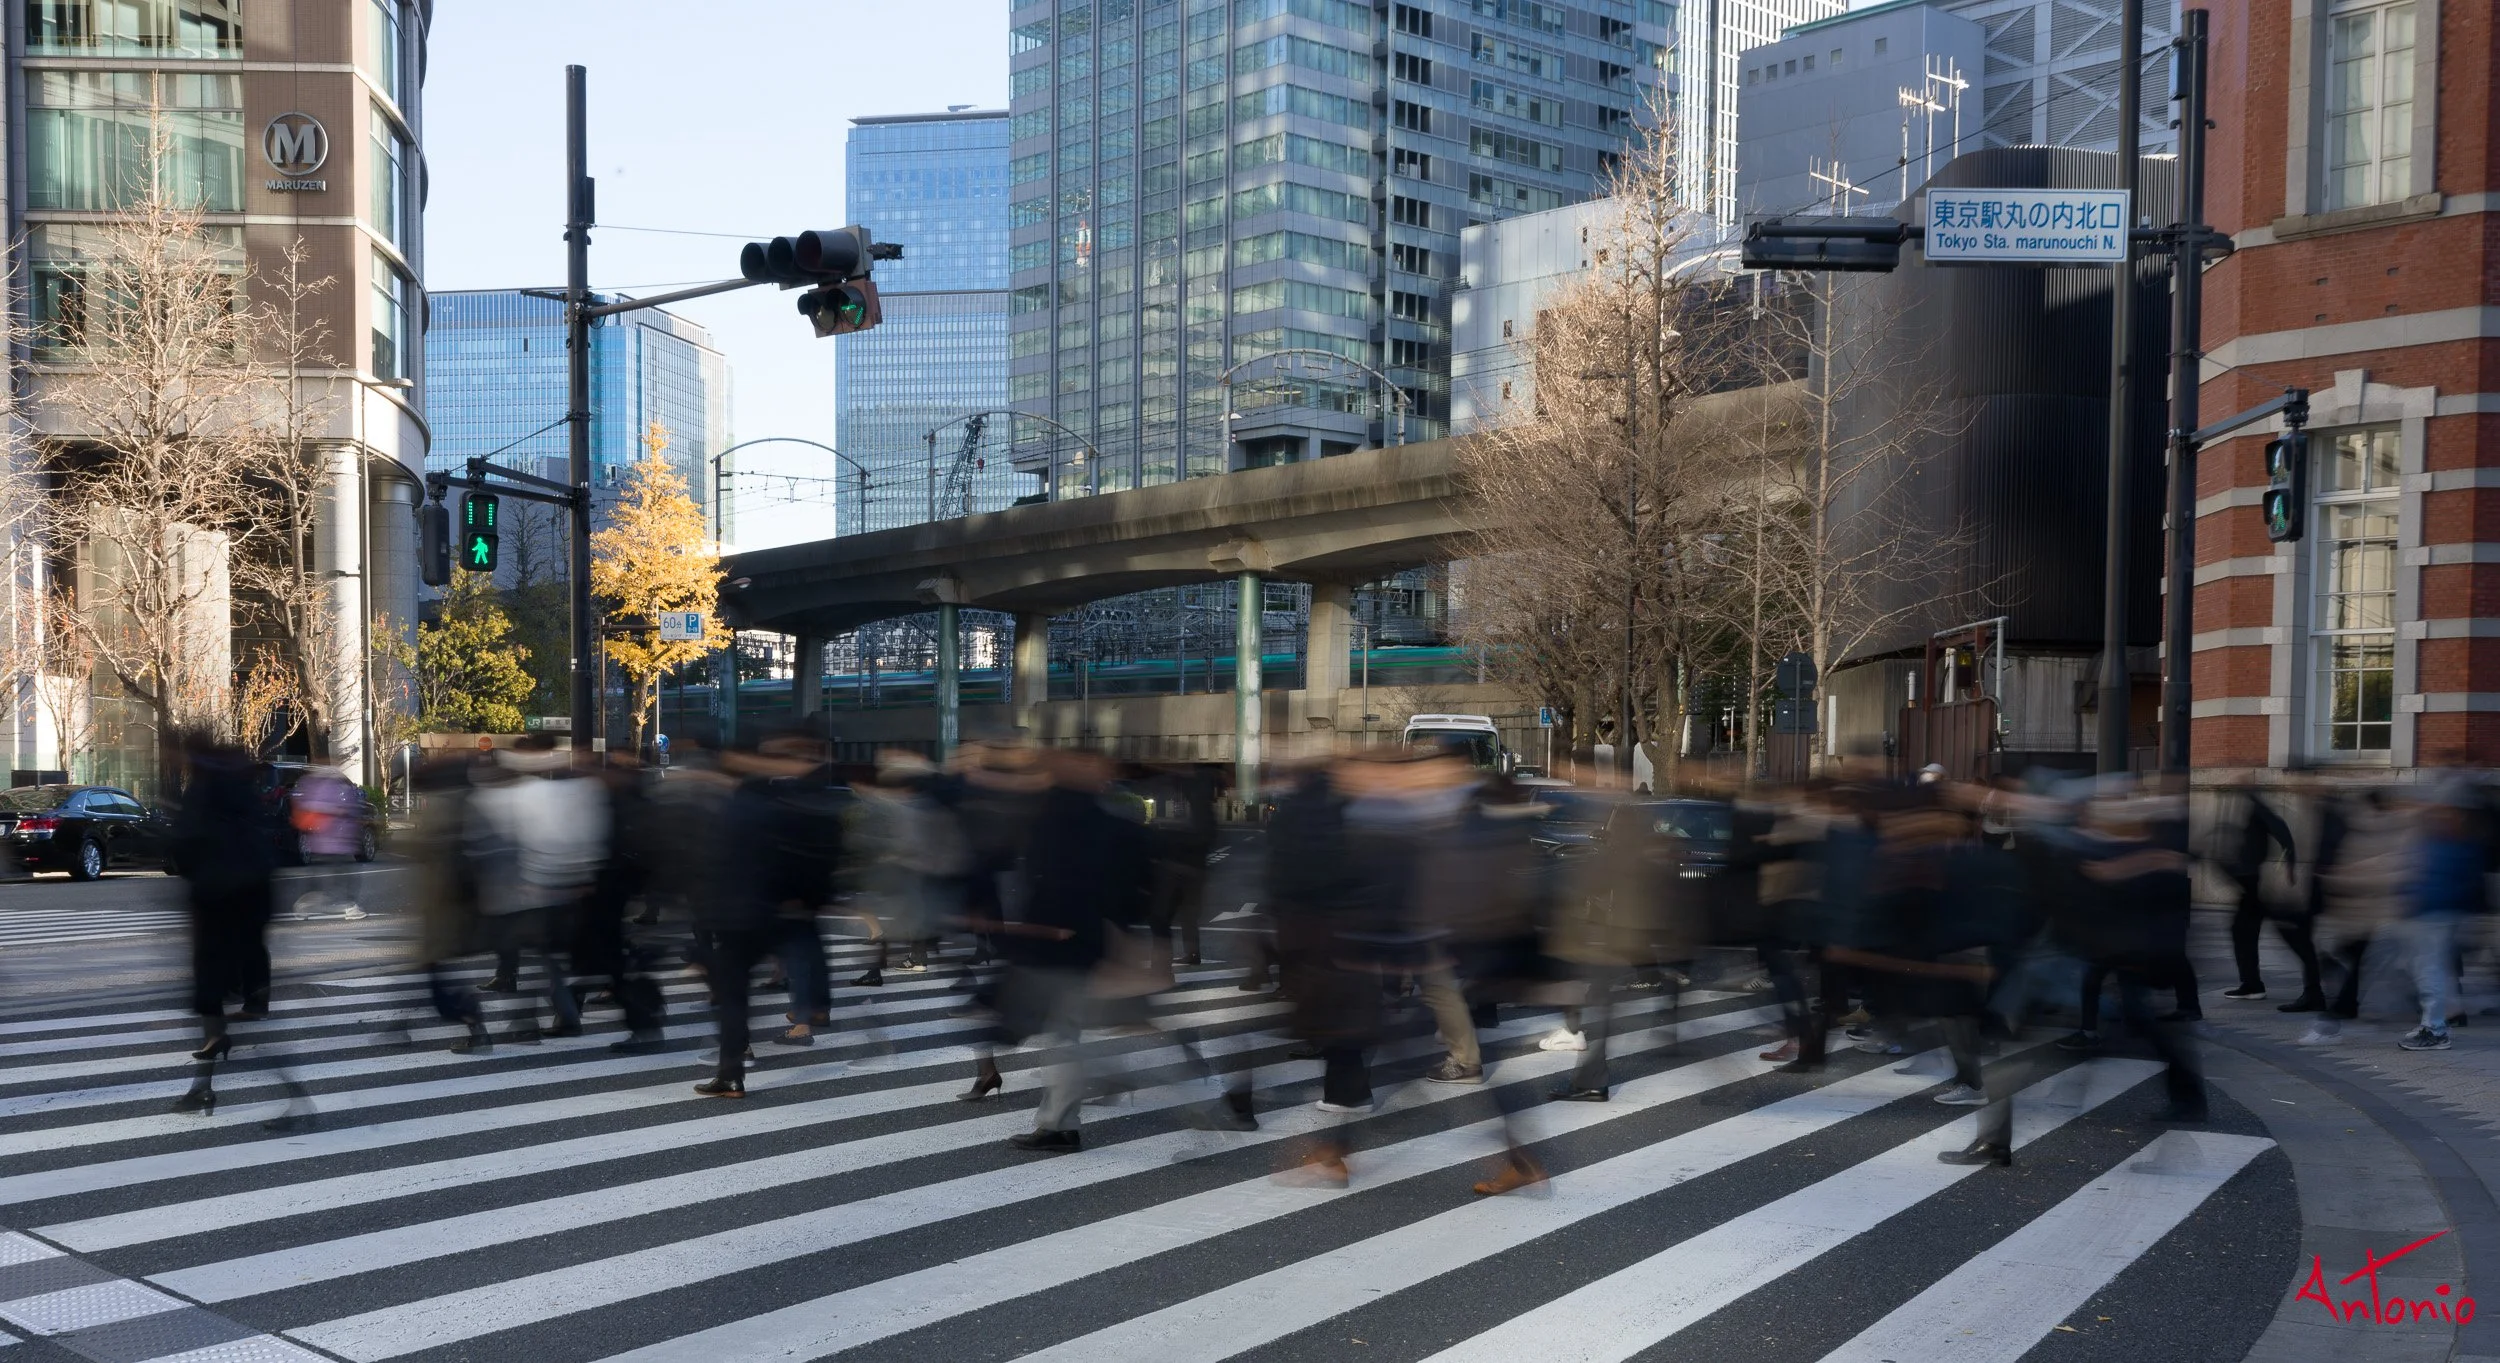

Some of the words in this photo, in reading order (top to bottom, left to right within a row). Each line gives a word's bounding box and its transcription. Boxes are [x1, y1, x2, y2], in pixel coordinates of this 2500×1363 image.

[272, 123, 317, 164] M
[265, 180, 326, 192] MARUZEN
[1933, 199, 2121, 230] 東京駅丸の内北口
[1936, 233, 1978, 251] Tokyo
[1983, 233, 2010, 249] Sta.
[2015, 236, 2098, 250] marunouchi
[2103, 237, 2117, 250] N.
[528, 718, 541, 726] JR
